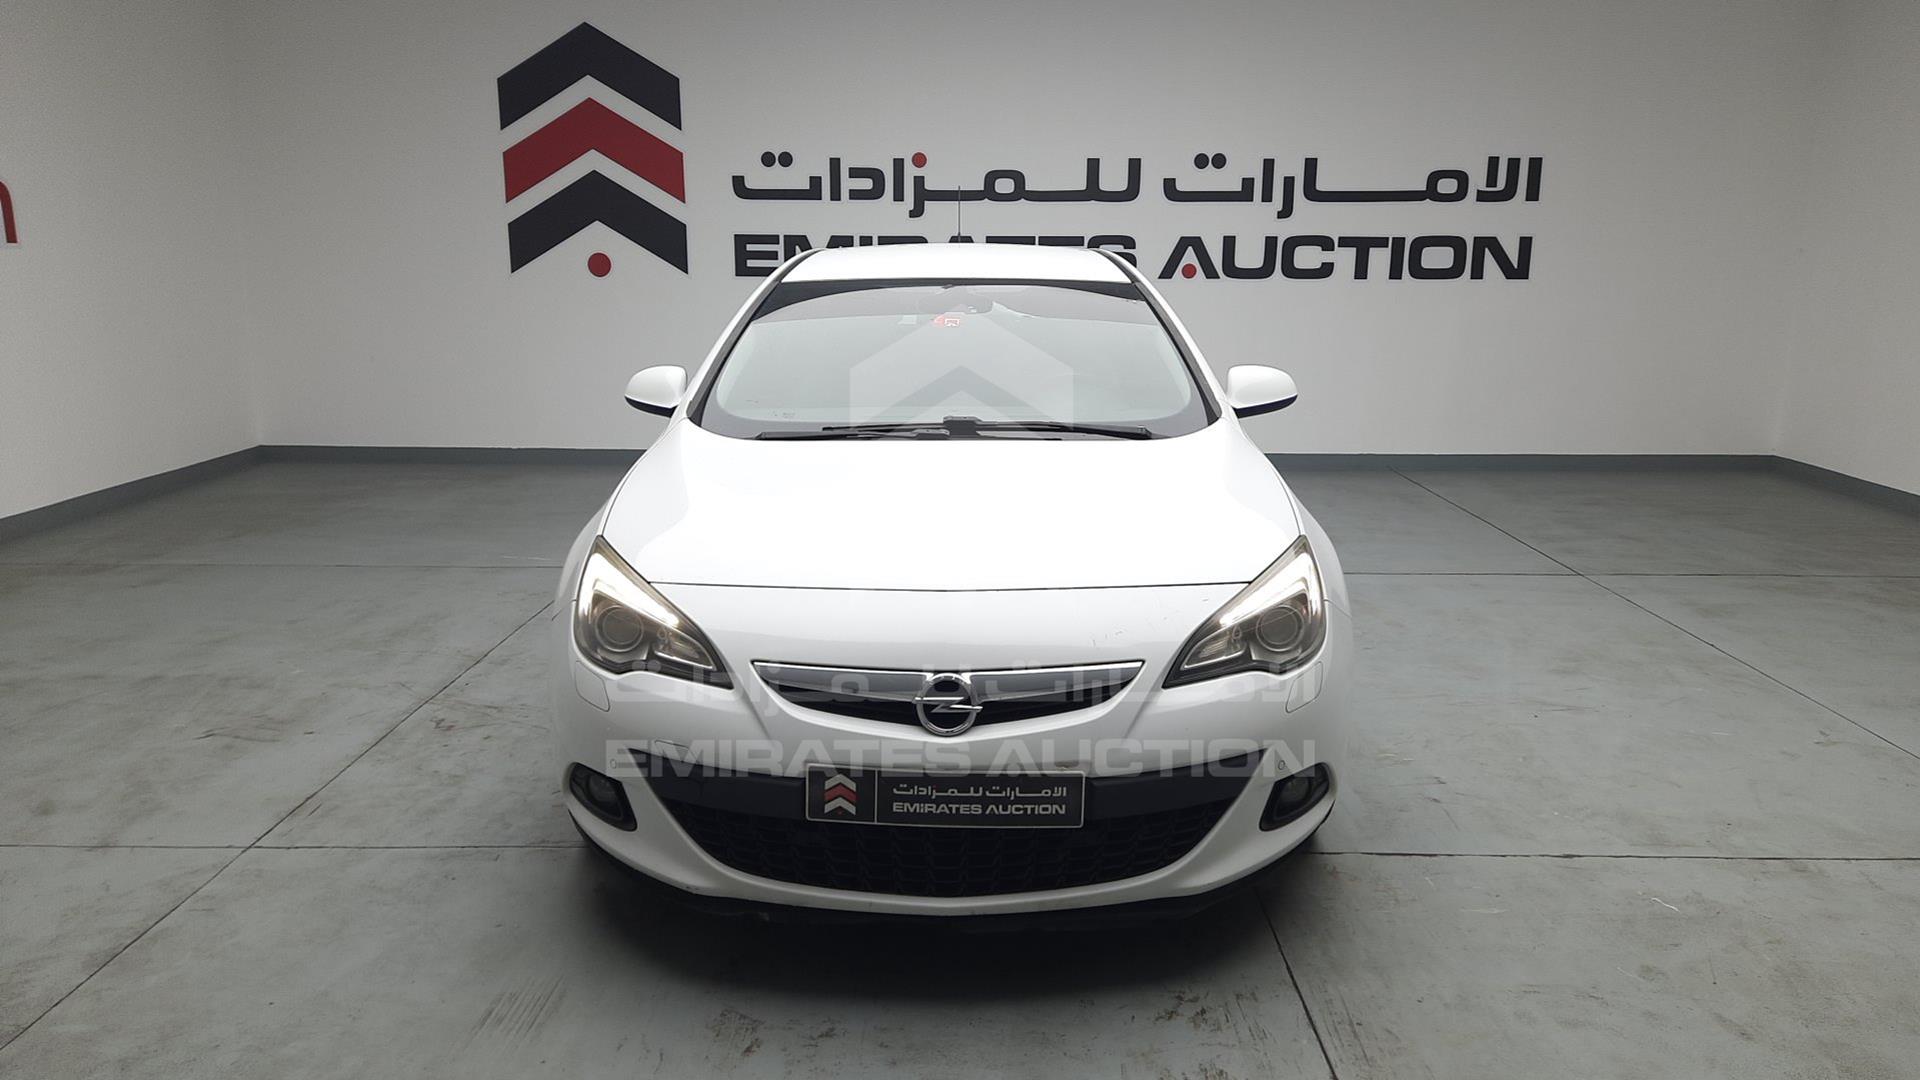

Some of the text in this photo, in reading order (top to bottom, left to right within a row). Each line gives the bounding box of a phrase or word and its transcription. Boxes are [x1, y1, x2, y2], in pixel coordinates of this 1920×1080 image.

[1157, 235, 1534, 281] AUCTION
[892, 802, 1066, 815] EMIRATES AUCTION
